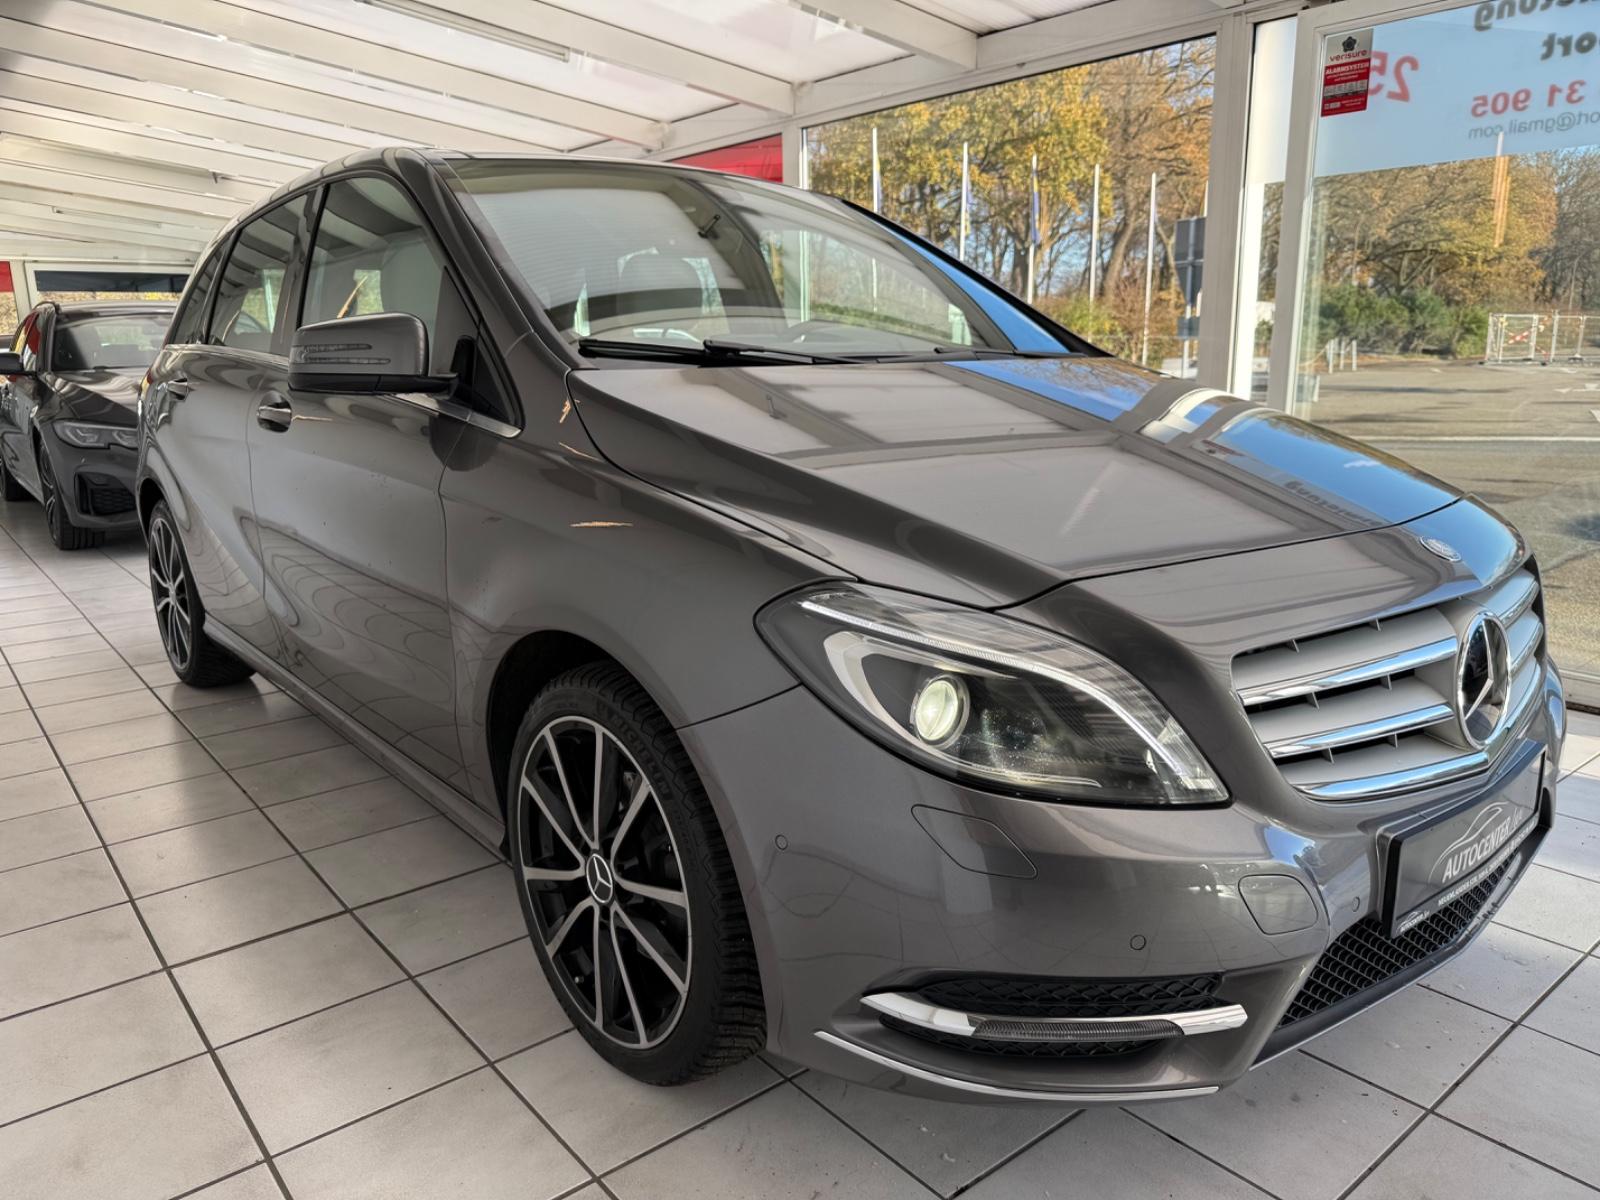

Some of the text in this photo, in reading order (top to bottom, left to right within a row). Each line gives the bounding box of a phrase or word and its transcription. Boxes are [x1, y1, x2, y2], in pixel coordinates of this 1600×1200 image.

[1329, 50, 1367, 61] verisure
[608, 708, 672, 799] MICHELIN
[1442, 815, 1511, 883] AUTOCENTER
